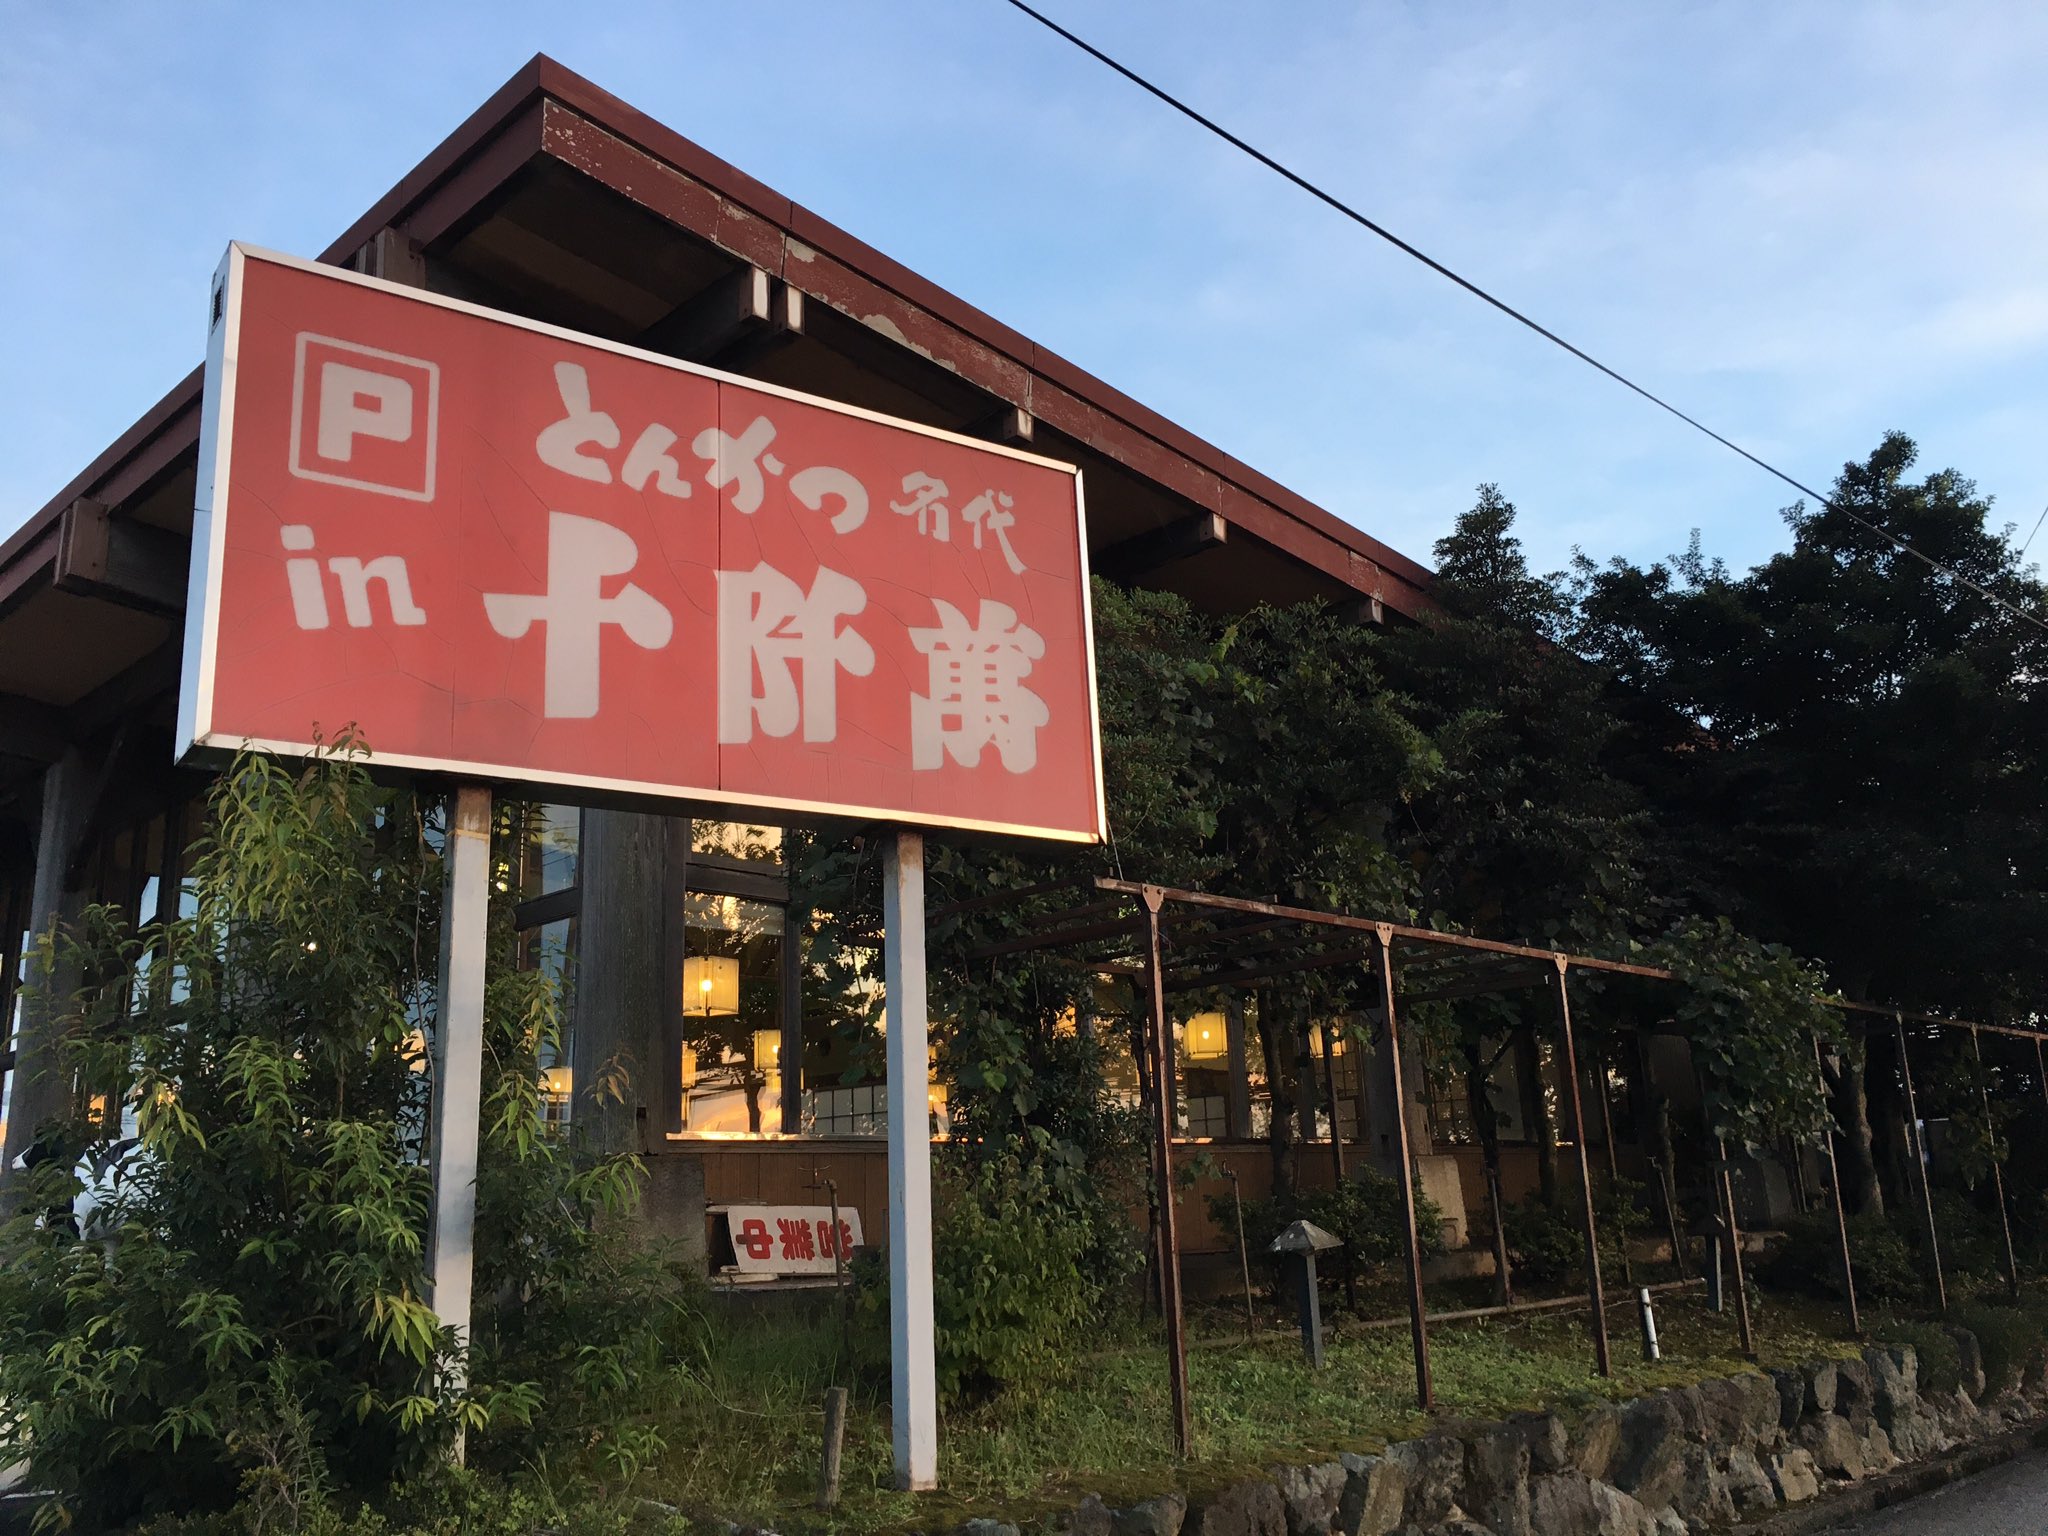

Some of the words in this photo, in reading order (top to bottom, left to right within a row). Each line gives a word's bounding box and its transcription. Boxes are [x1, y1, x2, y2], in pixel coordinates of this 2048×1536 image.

[316, 359, 415, 464] P
[535, 360, 870, 535] とんかつ
[889, 470, 1028, 576] 名代
[279, 523, 428, 631] in
